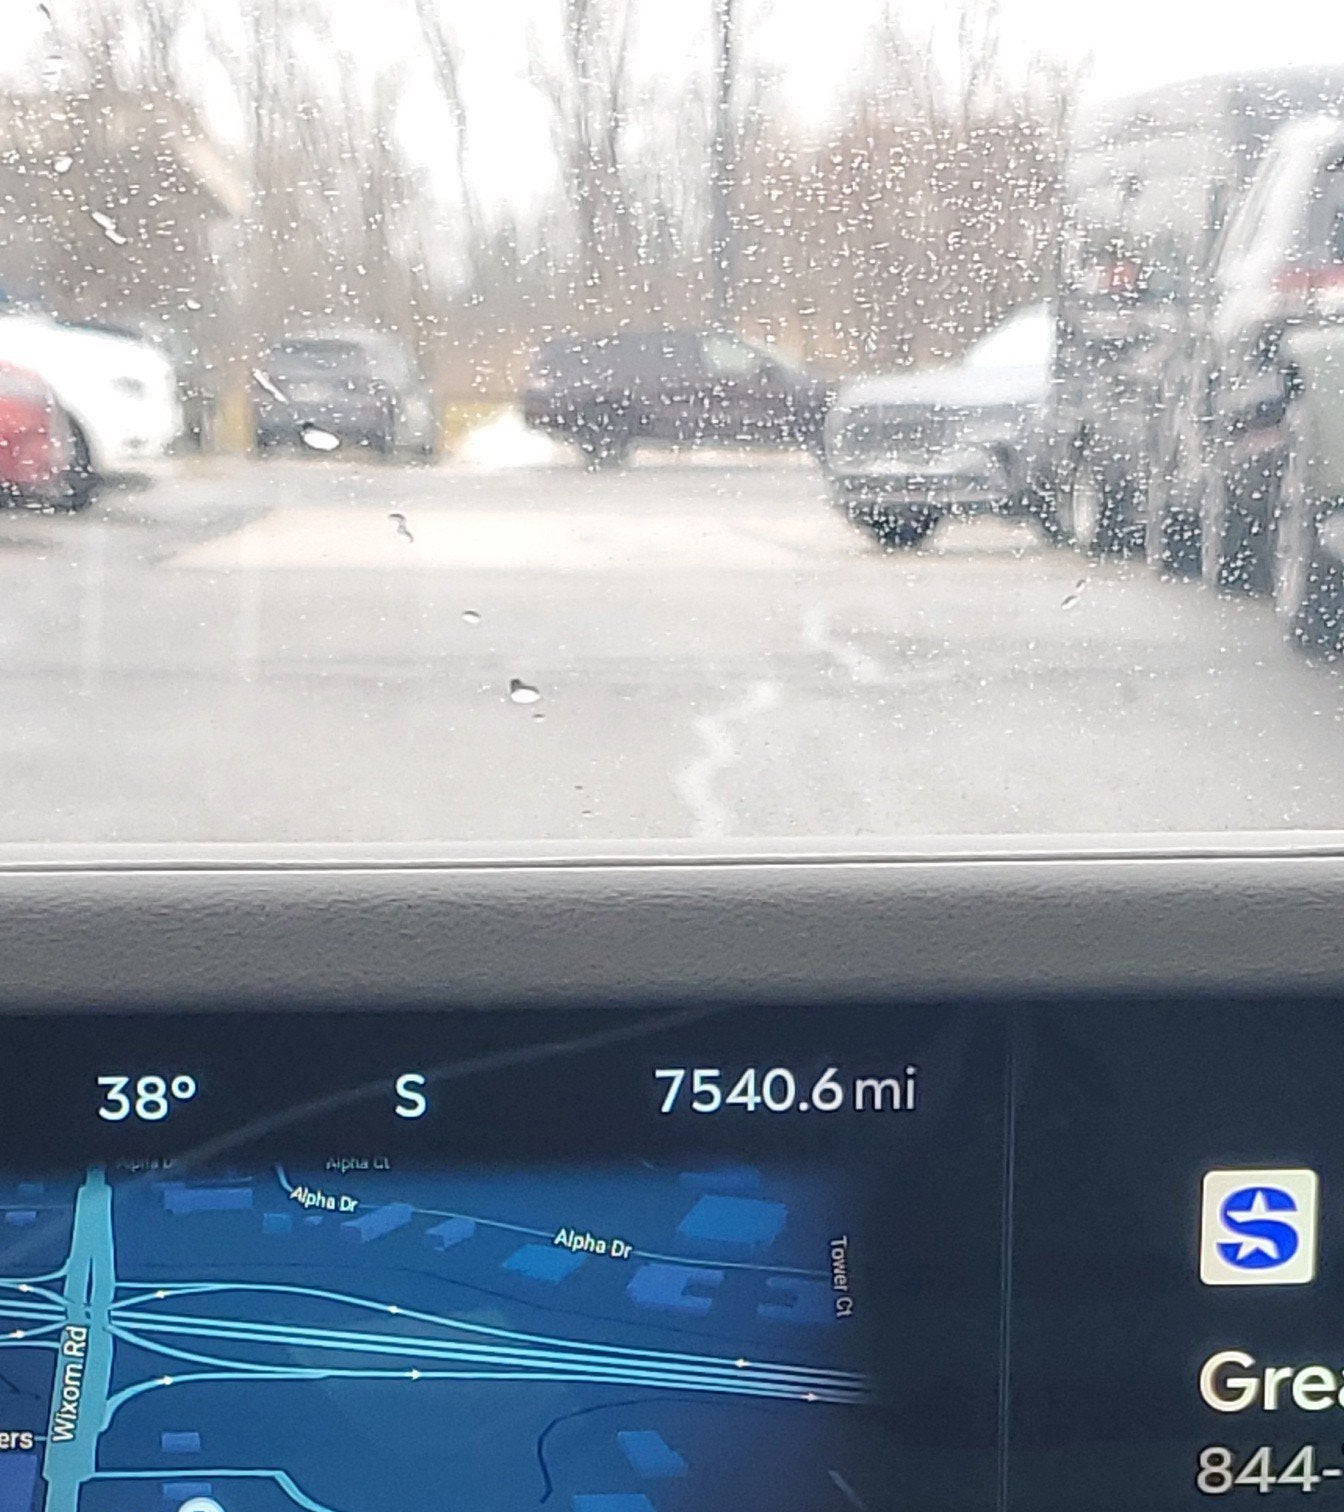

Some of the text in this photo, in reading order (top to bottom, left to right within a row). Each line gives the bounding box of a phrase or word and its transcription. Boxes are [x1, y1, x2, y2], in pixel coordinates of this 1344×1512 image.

[96, 1075, 198, 1122] 38°
[392, 1072, 430, 1120] S
[653, 1064, 918, 1113] 7540.6 mi
[289, 1186, 337, 1211] Alpha
[552, 1229, 633, 1259] Alpha Dr
[830, 1235, 854, 1318] Tower Ct
[51, 1324, 89, 1442] Wixom Rd
